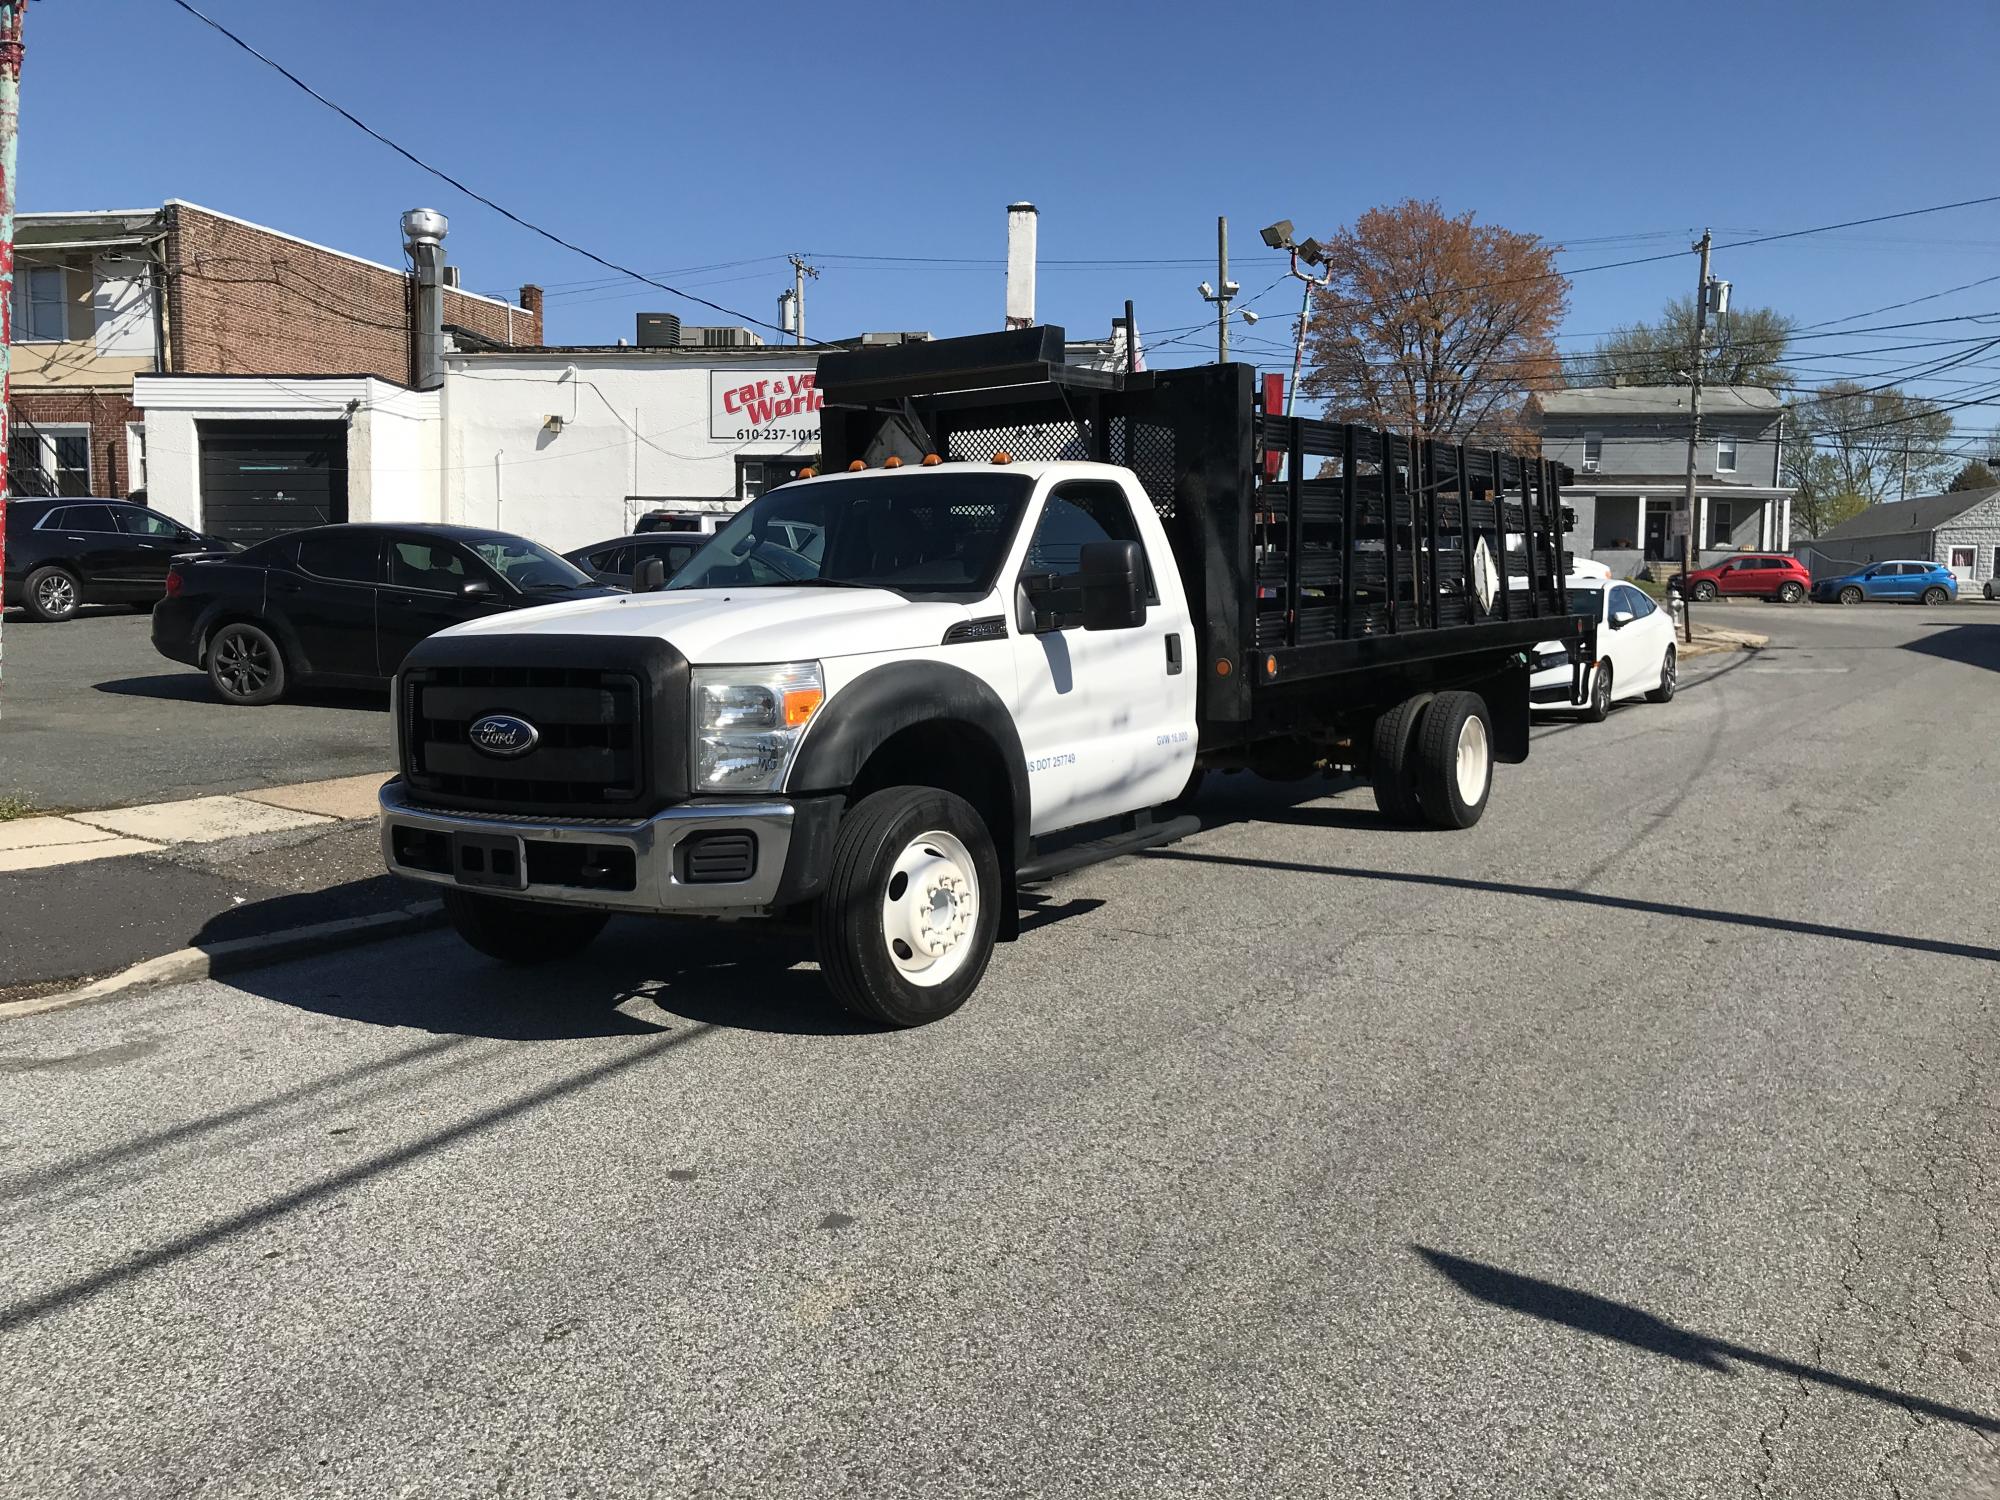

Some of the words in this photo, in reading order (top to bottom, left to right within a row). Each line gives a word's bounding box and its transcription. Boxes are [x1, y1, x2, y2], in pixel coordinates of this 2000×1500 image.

[723, 379, 768, 415] Car
[773, 381, 785, 395] &
[736, 429, 821, 440] 610-237-1015
[480, 721, 517, 745] Ford
[1036, 758, 1051, 771] DOT
[1052, 753, 1076, 768] 257749
